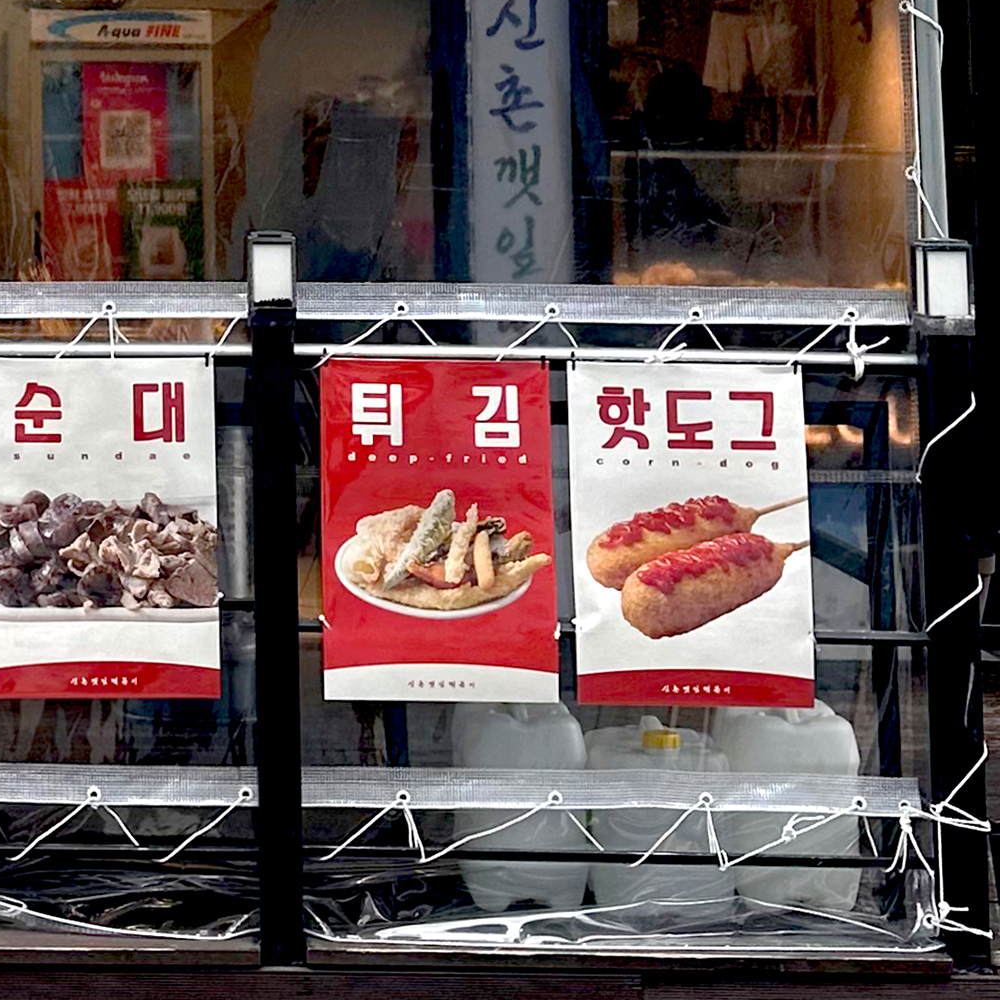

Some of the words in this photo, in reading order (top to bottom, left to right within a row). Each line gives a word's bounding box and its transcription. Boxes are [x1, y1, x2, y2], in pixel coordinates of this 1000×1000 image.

[596, 386, 777, 451] 핫도그
[13, 451, 191, 461] sundae
[347, 451, 528, 464] deep-fried
[596, 457, 779, 470] corn-dog
